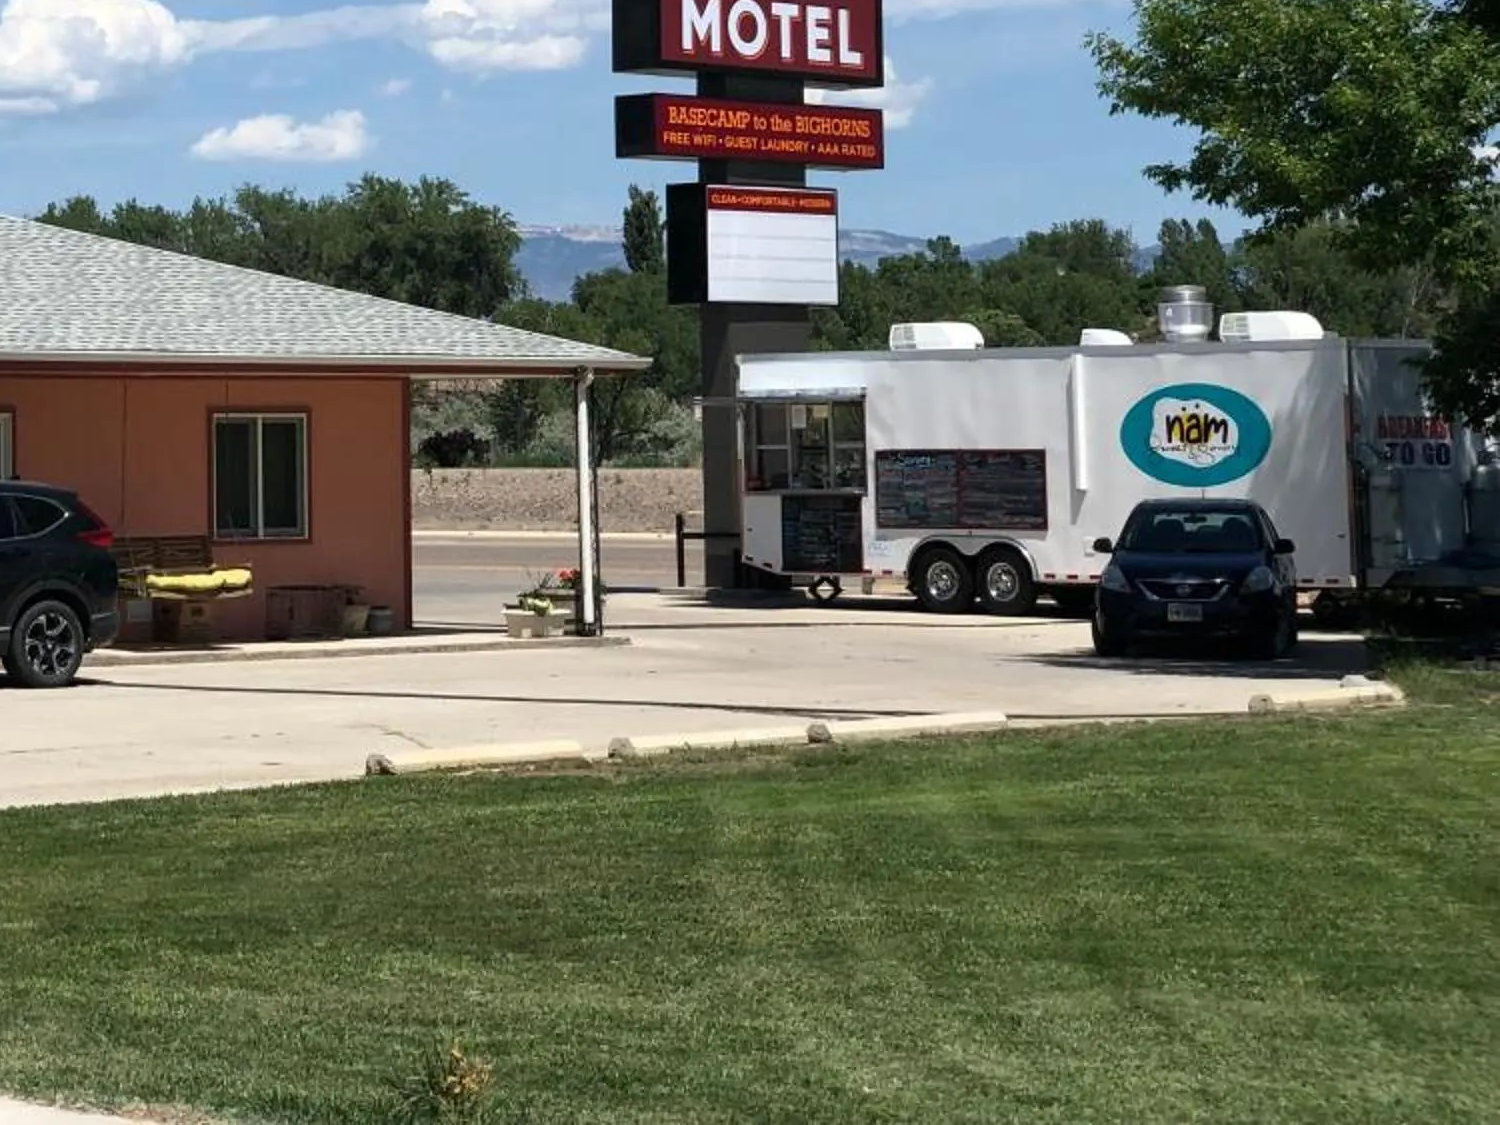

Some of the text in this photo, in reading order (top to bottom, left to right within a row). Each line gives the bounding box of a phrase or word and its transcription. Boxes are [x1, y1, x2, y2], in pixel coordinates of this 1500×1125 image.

[668, 106, 871, 138] BASECAMP to the BIGHORNS
[663, 131, 691, 145] FREE
[724, 135, 759, 150] GUEST
[761, 138, 809, 154] LAUNDRY
[817, 143, 841, 156] AAA
[841, 144, 876, 158] RATED
